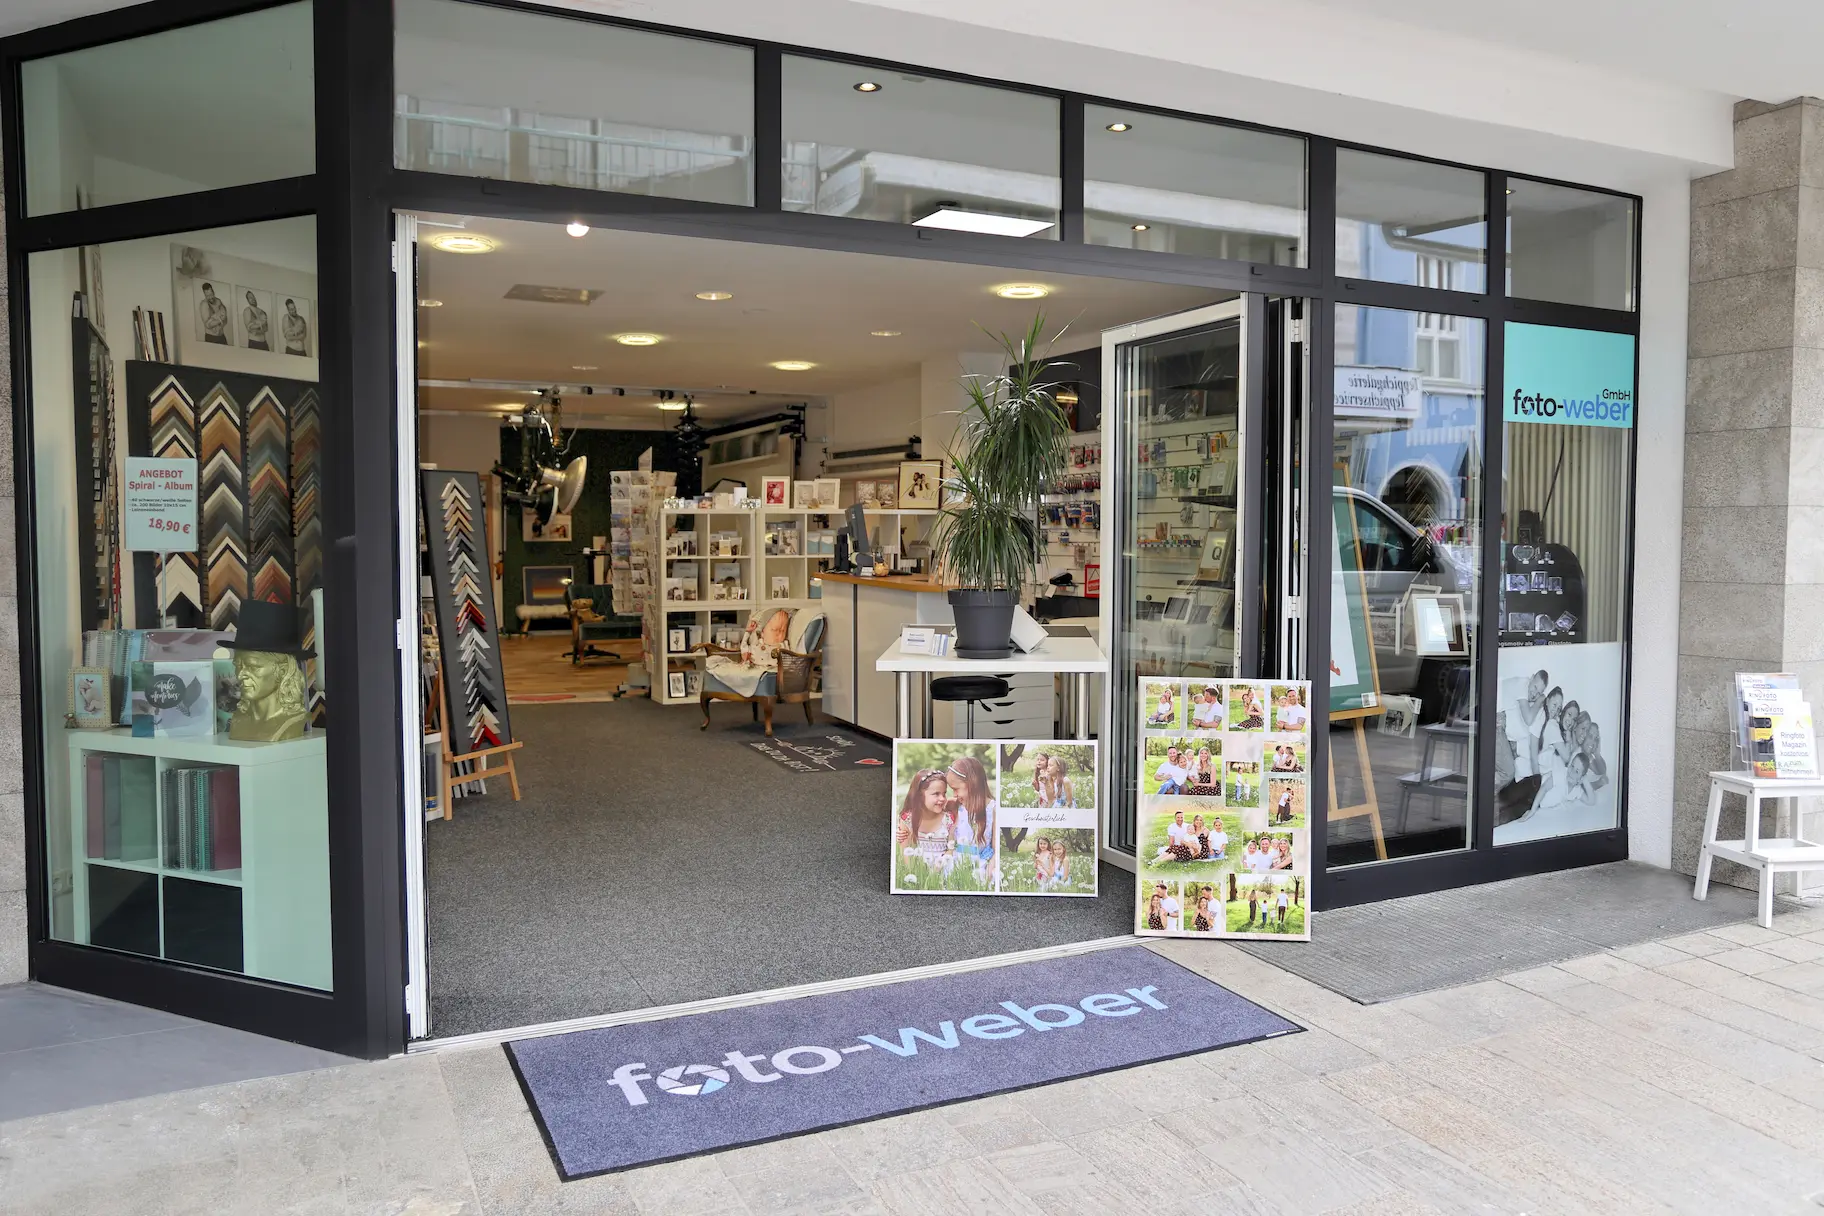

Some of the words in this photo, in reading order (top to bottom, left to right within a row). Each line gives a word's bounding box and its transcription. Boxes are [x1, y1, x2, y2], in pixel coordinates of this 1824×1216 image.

[1602, 388, 1631, 401] GmbH
[1513, 388, 1630, 421] foto-weber
[139, 469, 184, 479] ANGEBOT
[128, 481, 155, 491] Spiral
[164, 481, 193, 490] Album
[148, 518, 180, 532] 18,90
[182, 523, 191, 534] €
[1780, 731, 1805, 740] Ringfoto
[1781, 741, 1807, 749] Magazin
[606, 984, 1169, 1106] foto-weber
